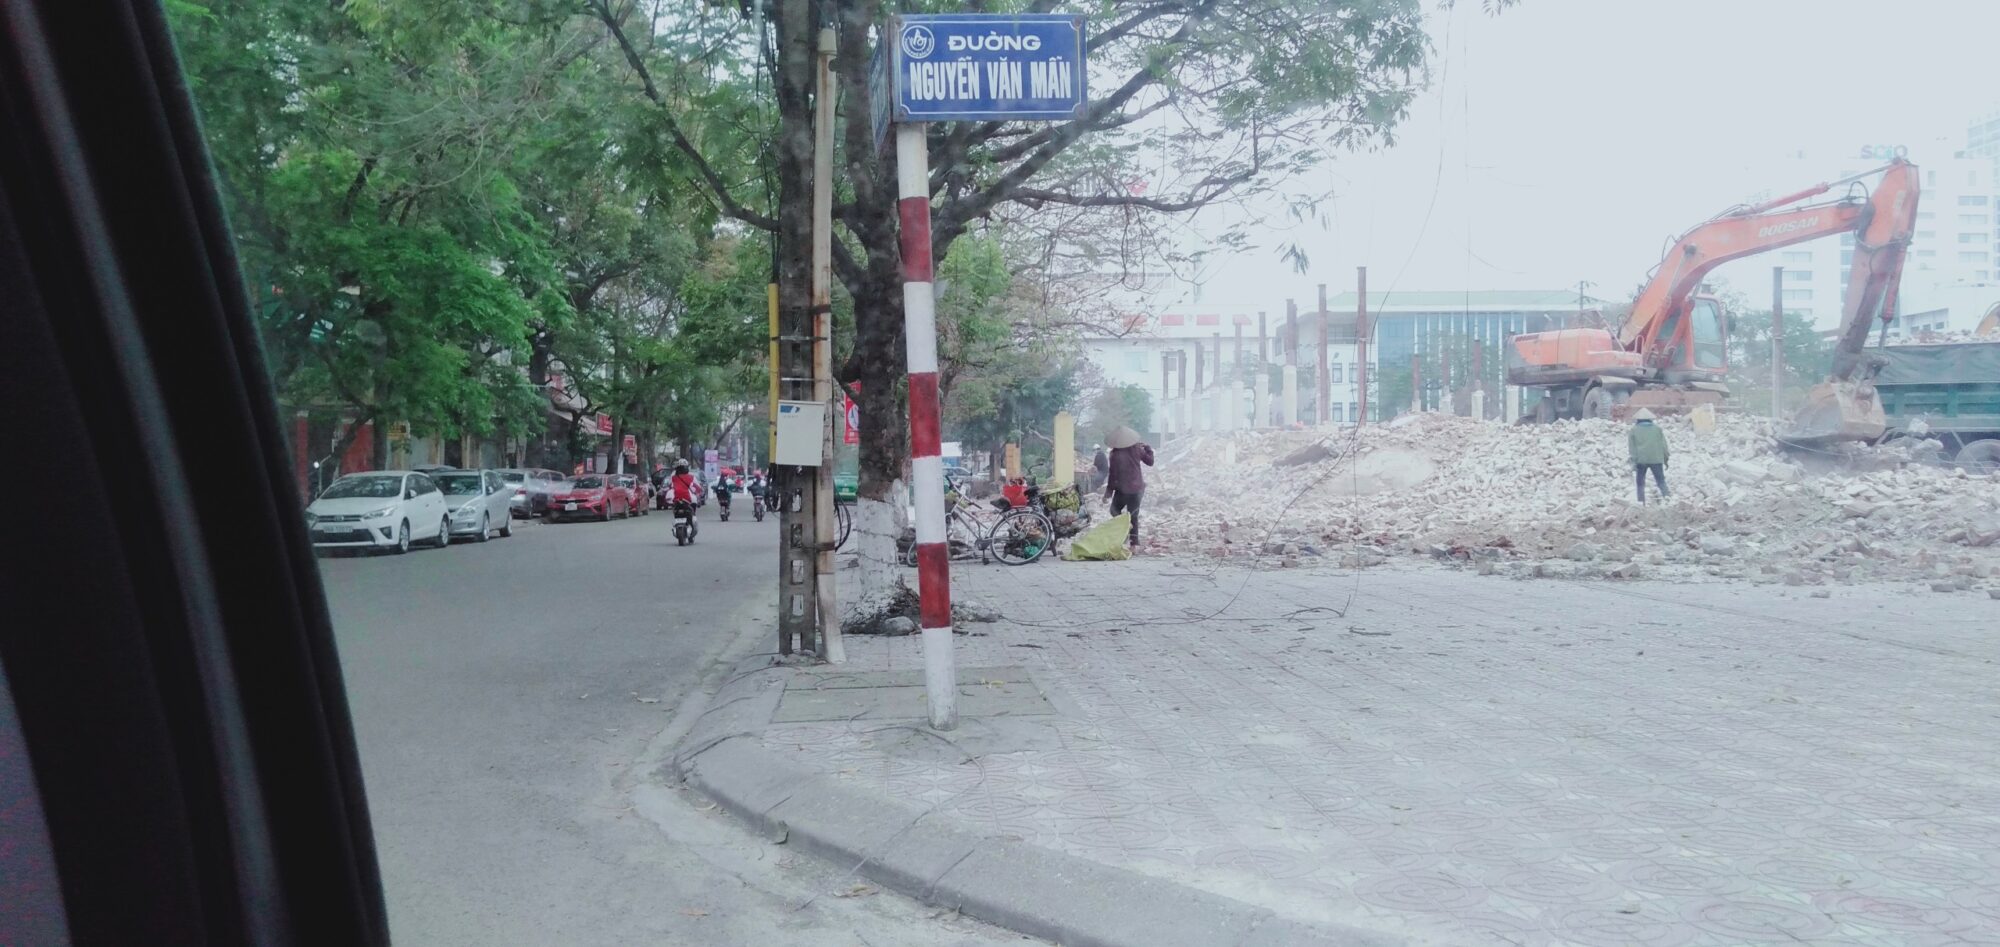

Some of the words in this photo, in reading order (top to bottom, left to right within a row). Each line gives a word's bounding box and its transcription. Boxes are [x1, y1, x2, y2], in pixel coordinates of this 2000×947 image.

[909, 56, 980, 100] NGUYỄN
[986, 56, 1023, 100] VĂN
[1030, 55, 1072, 99] MẪN
[1758, 215, 1820, 238] DOOSAN
